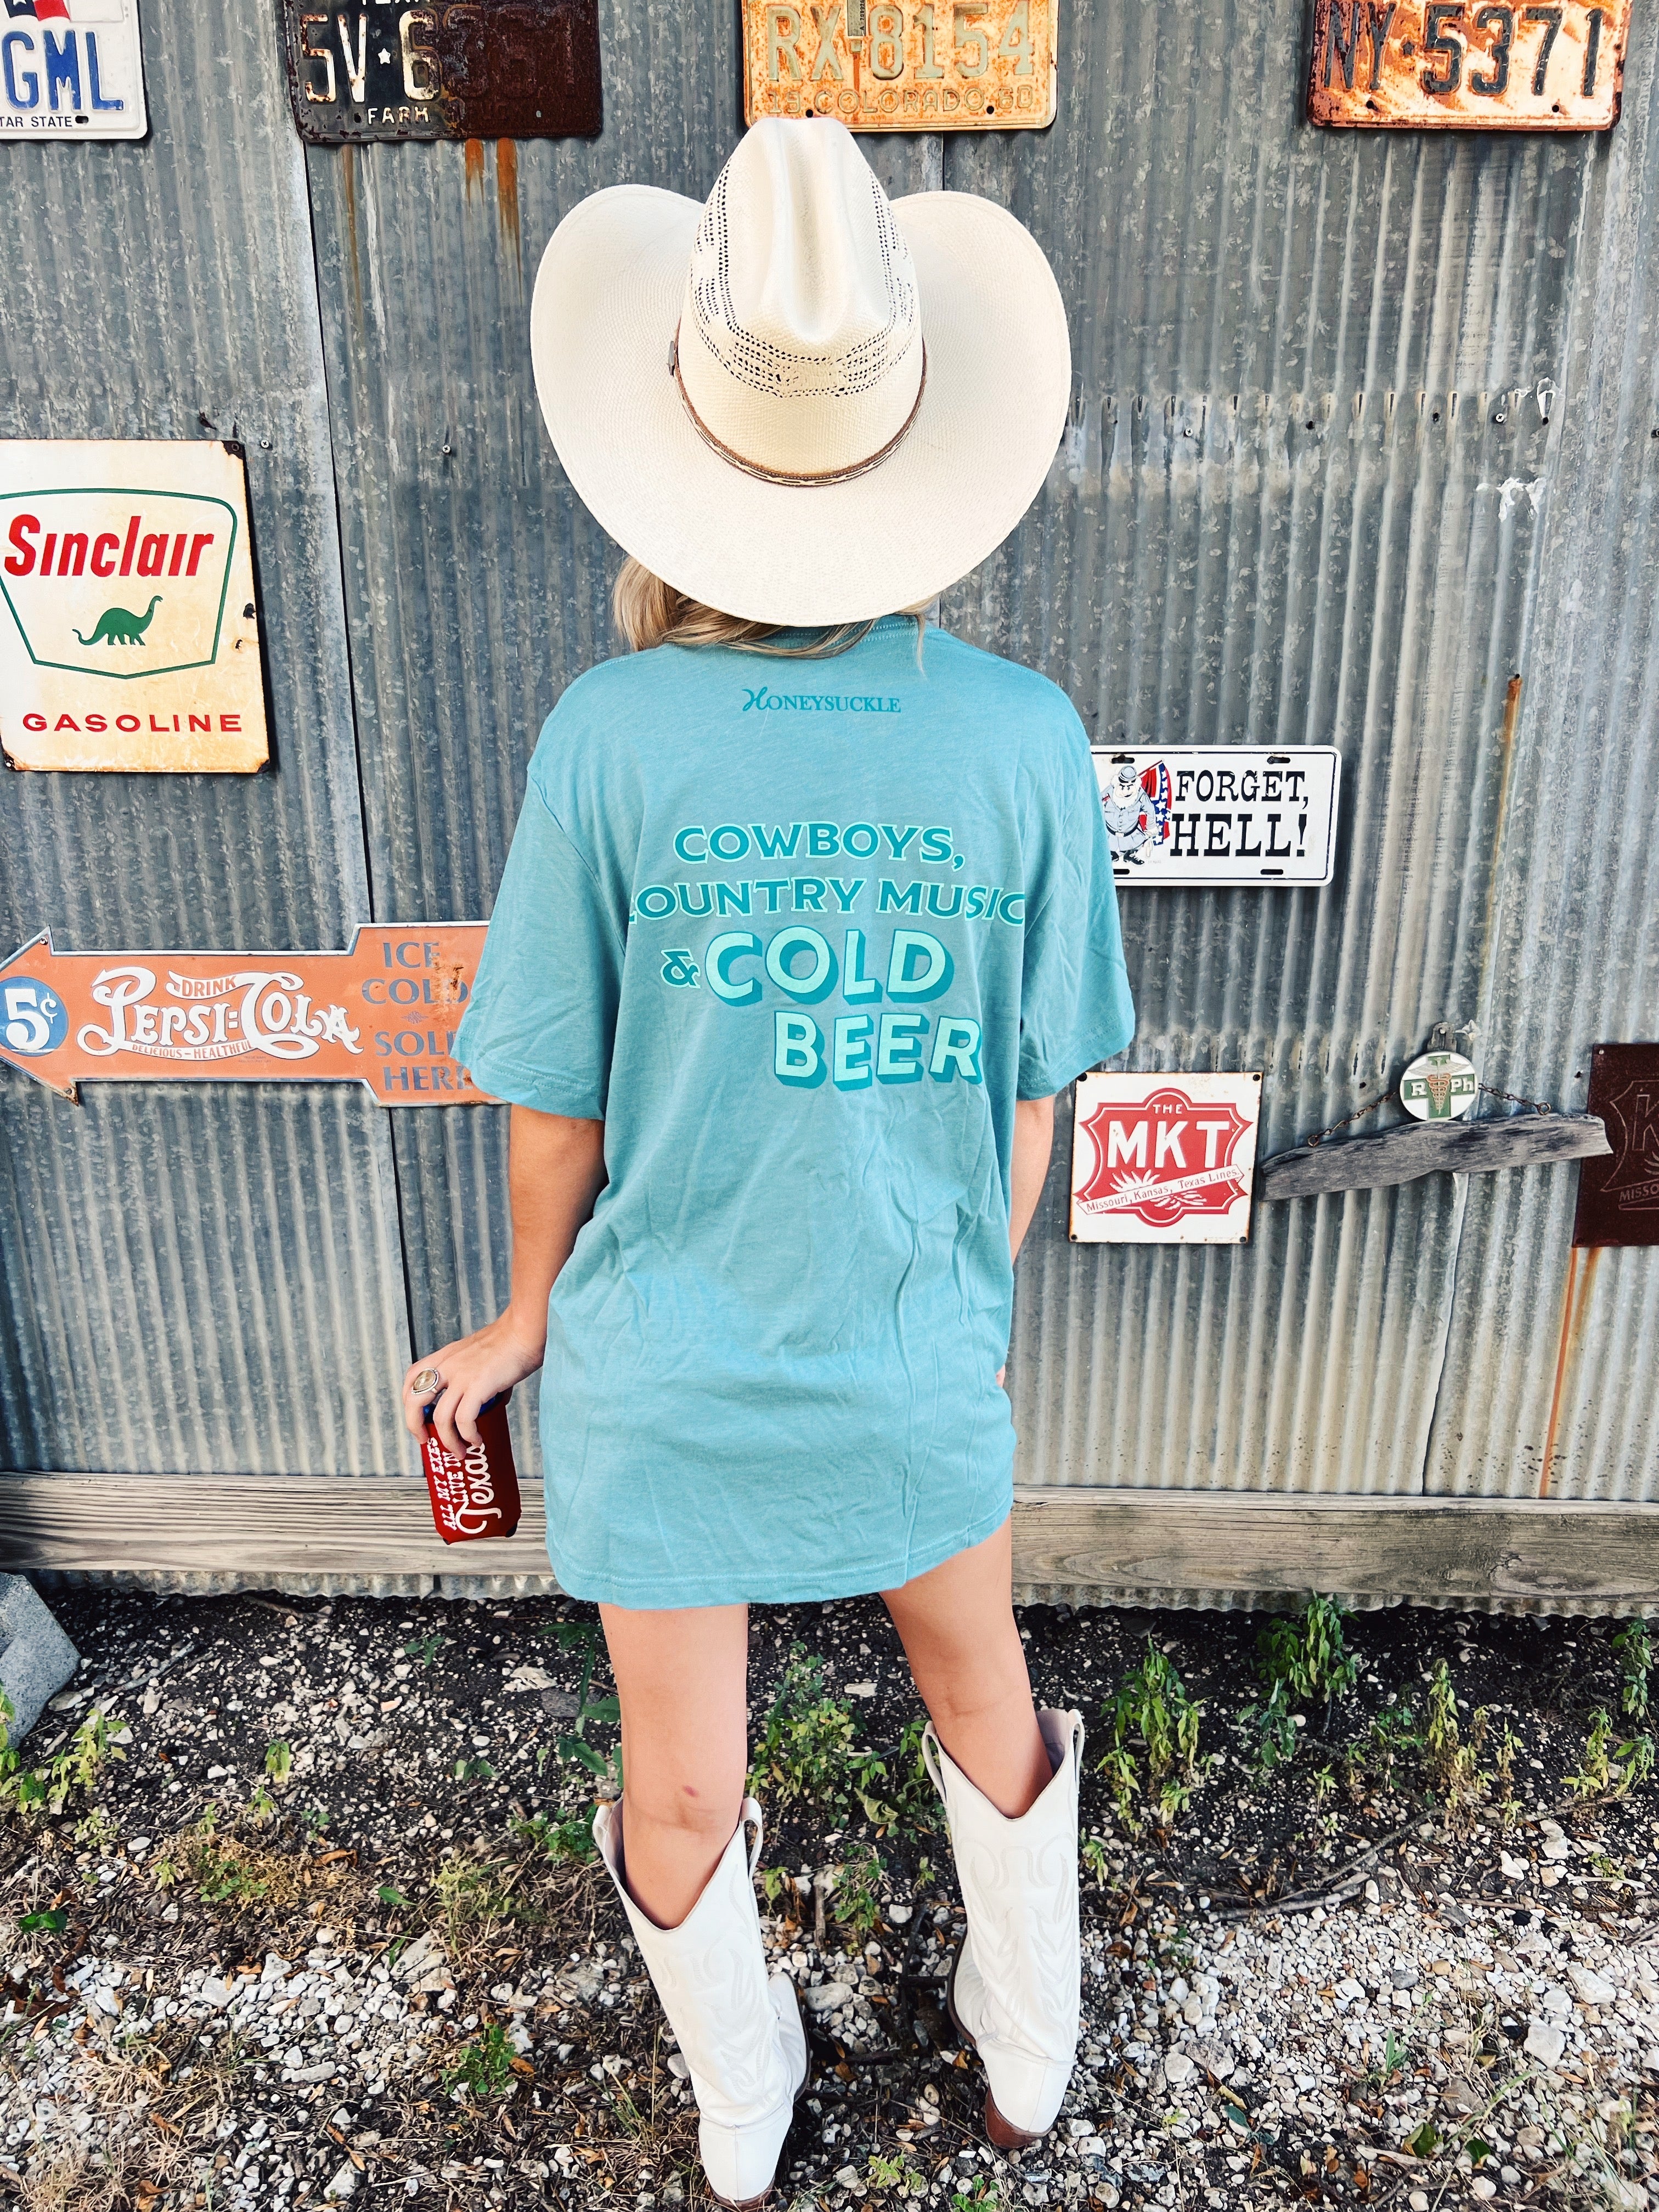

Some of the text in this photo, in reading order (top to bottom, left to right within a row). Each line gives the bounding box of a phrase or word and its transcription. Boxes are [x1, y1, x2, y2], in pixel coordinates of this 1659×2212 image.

[2, 30, 124, 111] GML
[1422, 4, 1605, 95] 5371
[31, 116, 72, 127] STATE
[368, 106, 429, 124] FARM
[814, 86, 987, 115] COLORADO
[4, 514, 215, 578] Sinclair
[22, 713, 242, 732] GASOLINE
[1175, 770, 1308, 809] FORGET,
[673, 822, 966, 872] COWBOYS,
[1170, 814, 1307, 857] HELL!
[629, 876, 866, 925] OUNTRY
[876, 879, 1025, 927] MUSIC
[182, 975, 238, 997] DRINK
[660, 924, 955, 1008] & COLD
[773, 1010, 983, 1092] BEER
[1153, 1104, 1182, 1114] THE
[1107, 1121, 1229, 1169] MKT
[1086, 1195, 1133, 1212] Missouri,
[1133, 1184, 1173, 1201] Kansas,
[1177, 1176, 1206, 1189] Texas
[433, 1475, 450, 1502] MY
[442, 1451, 470, 1503] LIVE IN
[439, 1504, 458, 1531] ALL
